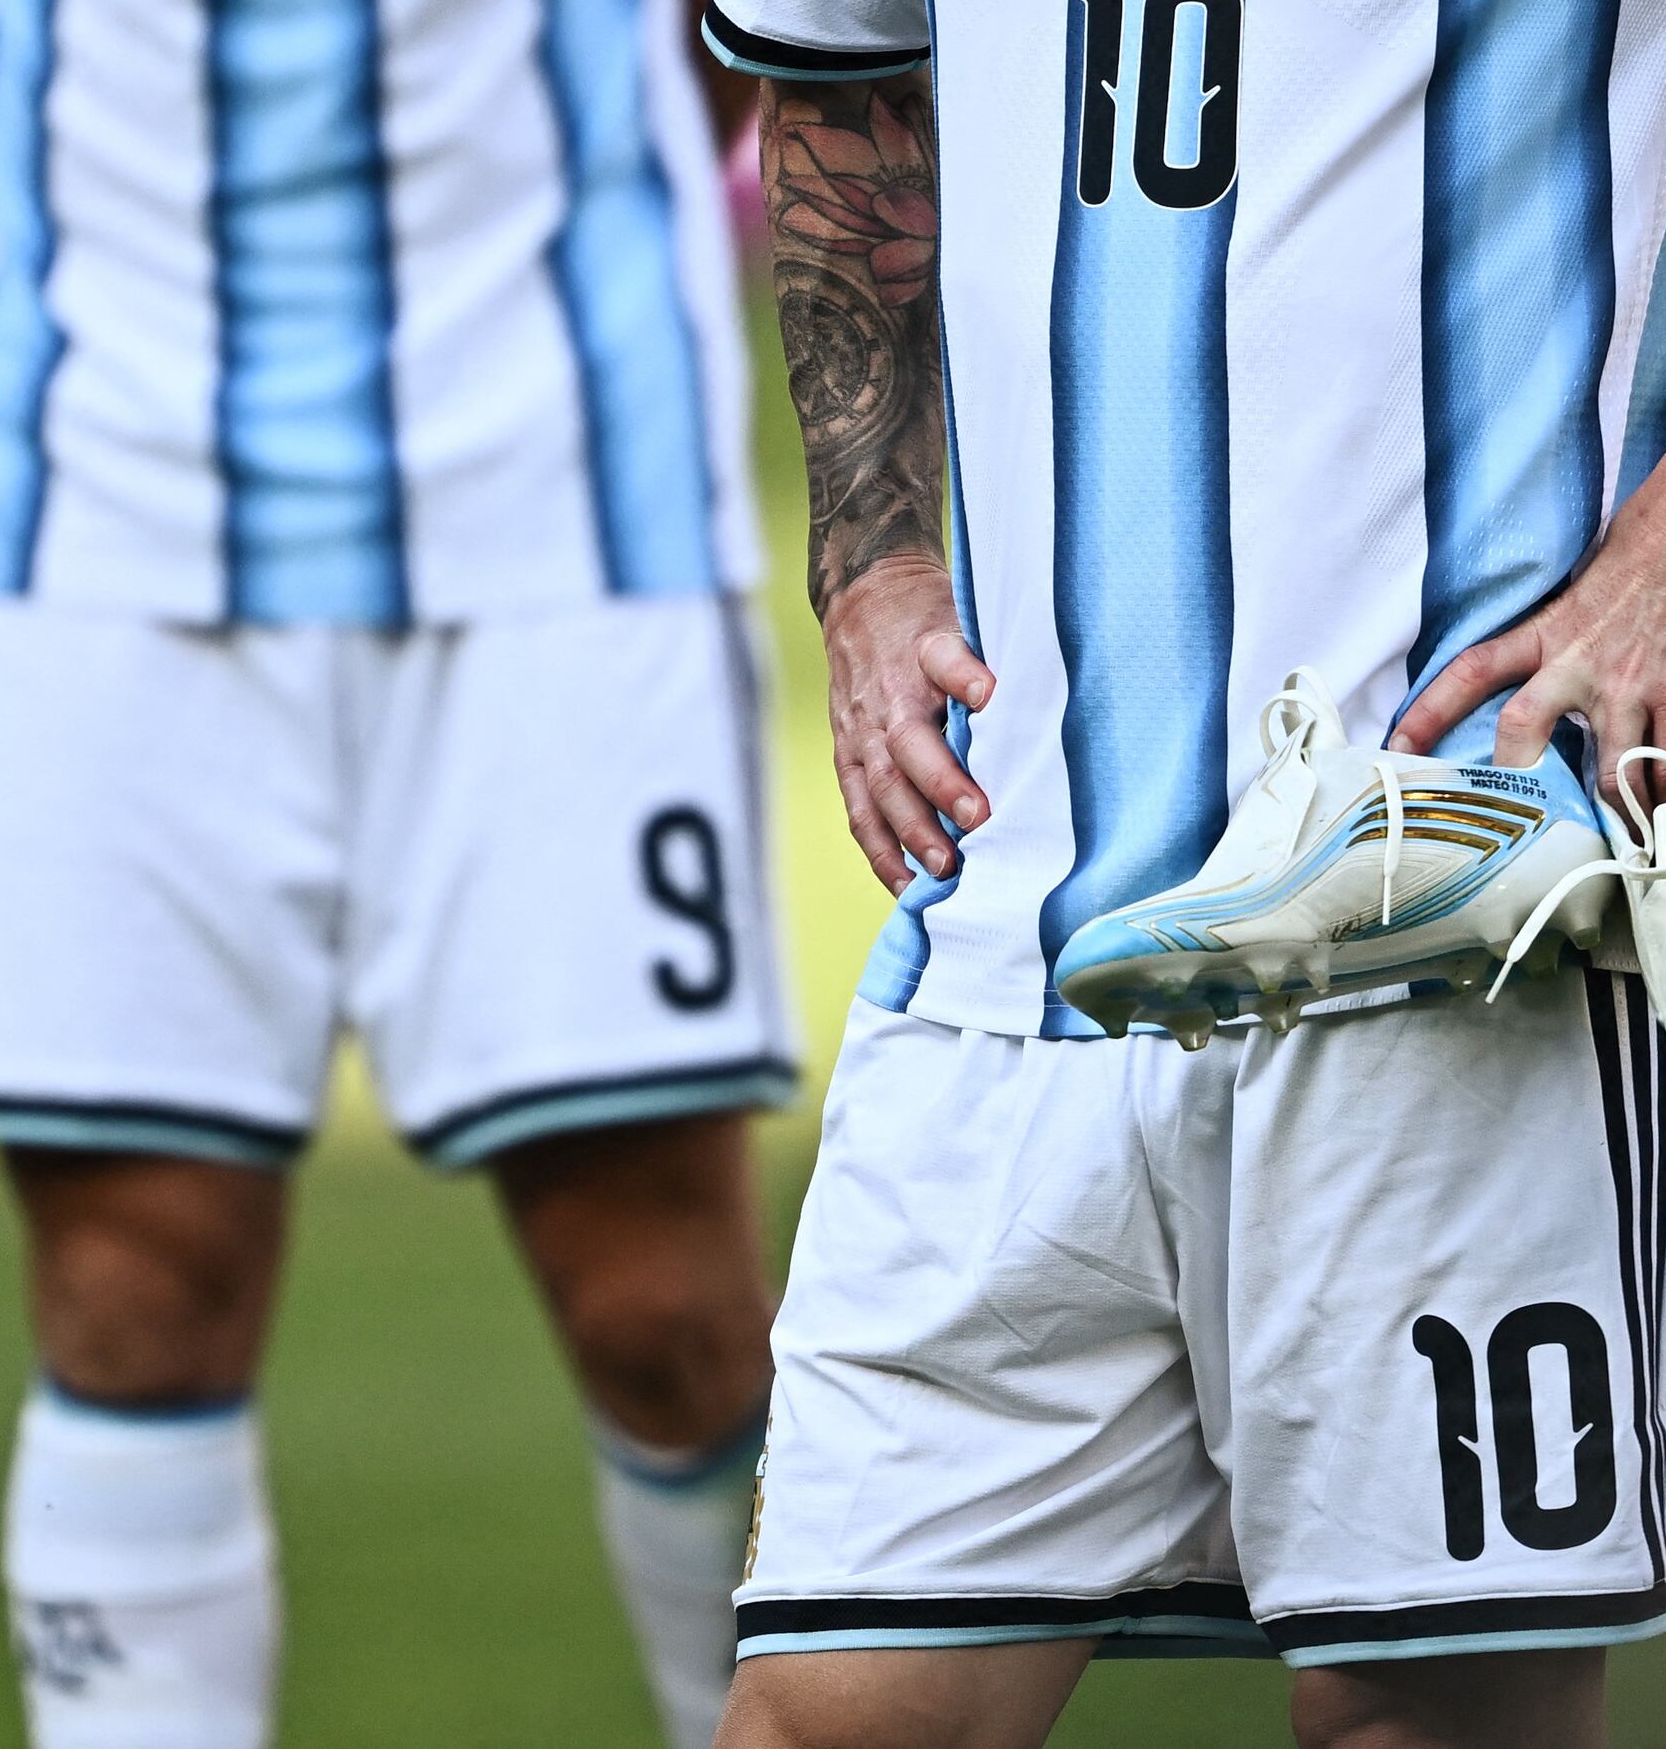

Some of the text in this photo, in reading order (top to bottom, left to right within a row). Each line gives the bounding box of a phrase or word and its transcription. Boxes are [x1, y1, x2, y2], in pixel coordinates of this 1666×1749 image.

[1457, 769, 1540, 787] THIAGO 02 11 12
[1471, 779, 1509, 791] MATEO
[1512, 784, 1520, 793] 11
[1521, 786, 1534, 796] 09
[638, 801, 737, 1013] 9
[1411, 1301, 1617, 1561] 10
